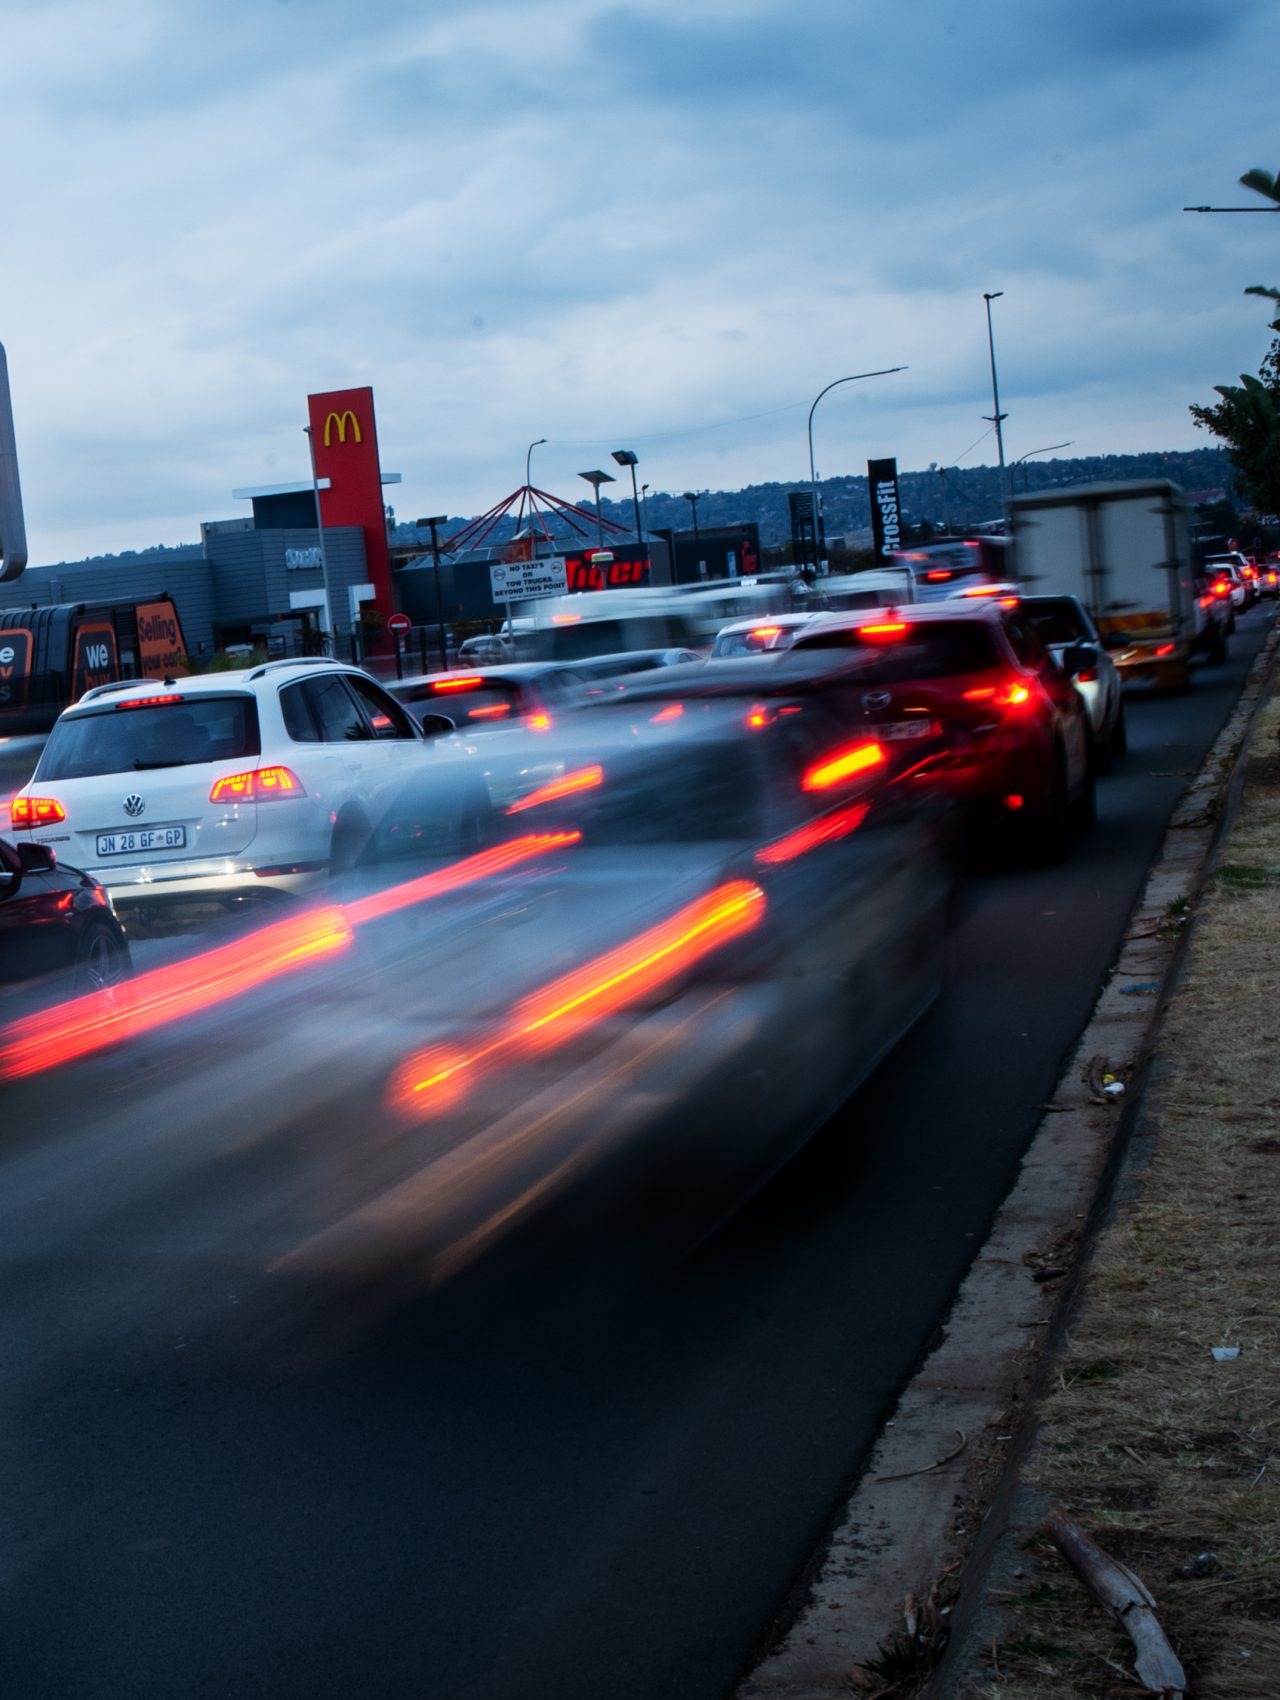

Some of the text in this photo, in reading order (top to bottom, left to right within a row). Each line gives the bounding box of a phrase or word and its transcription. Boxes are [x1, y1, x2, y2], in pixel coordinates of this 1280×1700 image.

[521, 562, 544, 571] TAXI'S
[494, 588, 523, 597] BEYOND
[526, 585, 542, 593] THIS
[544, 582, 565, 590] POINT
[505, 577, 552, 588] TOW TRUCKS
[138, 615, 176, 645] Selling
[86, 643, 108, 669] we
[101, 829, 181, 853] JN 28 GF GP
